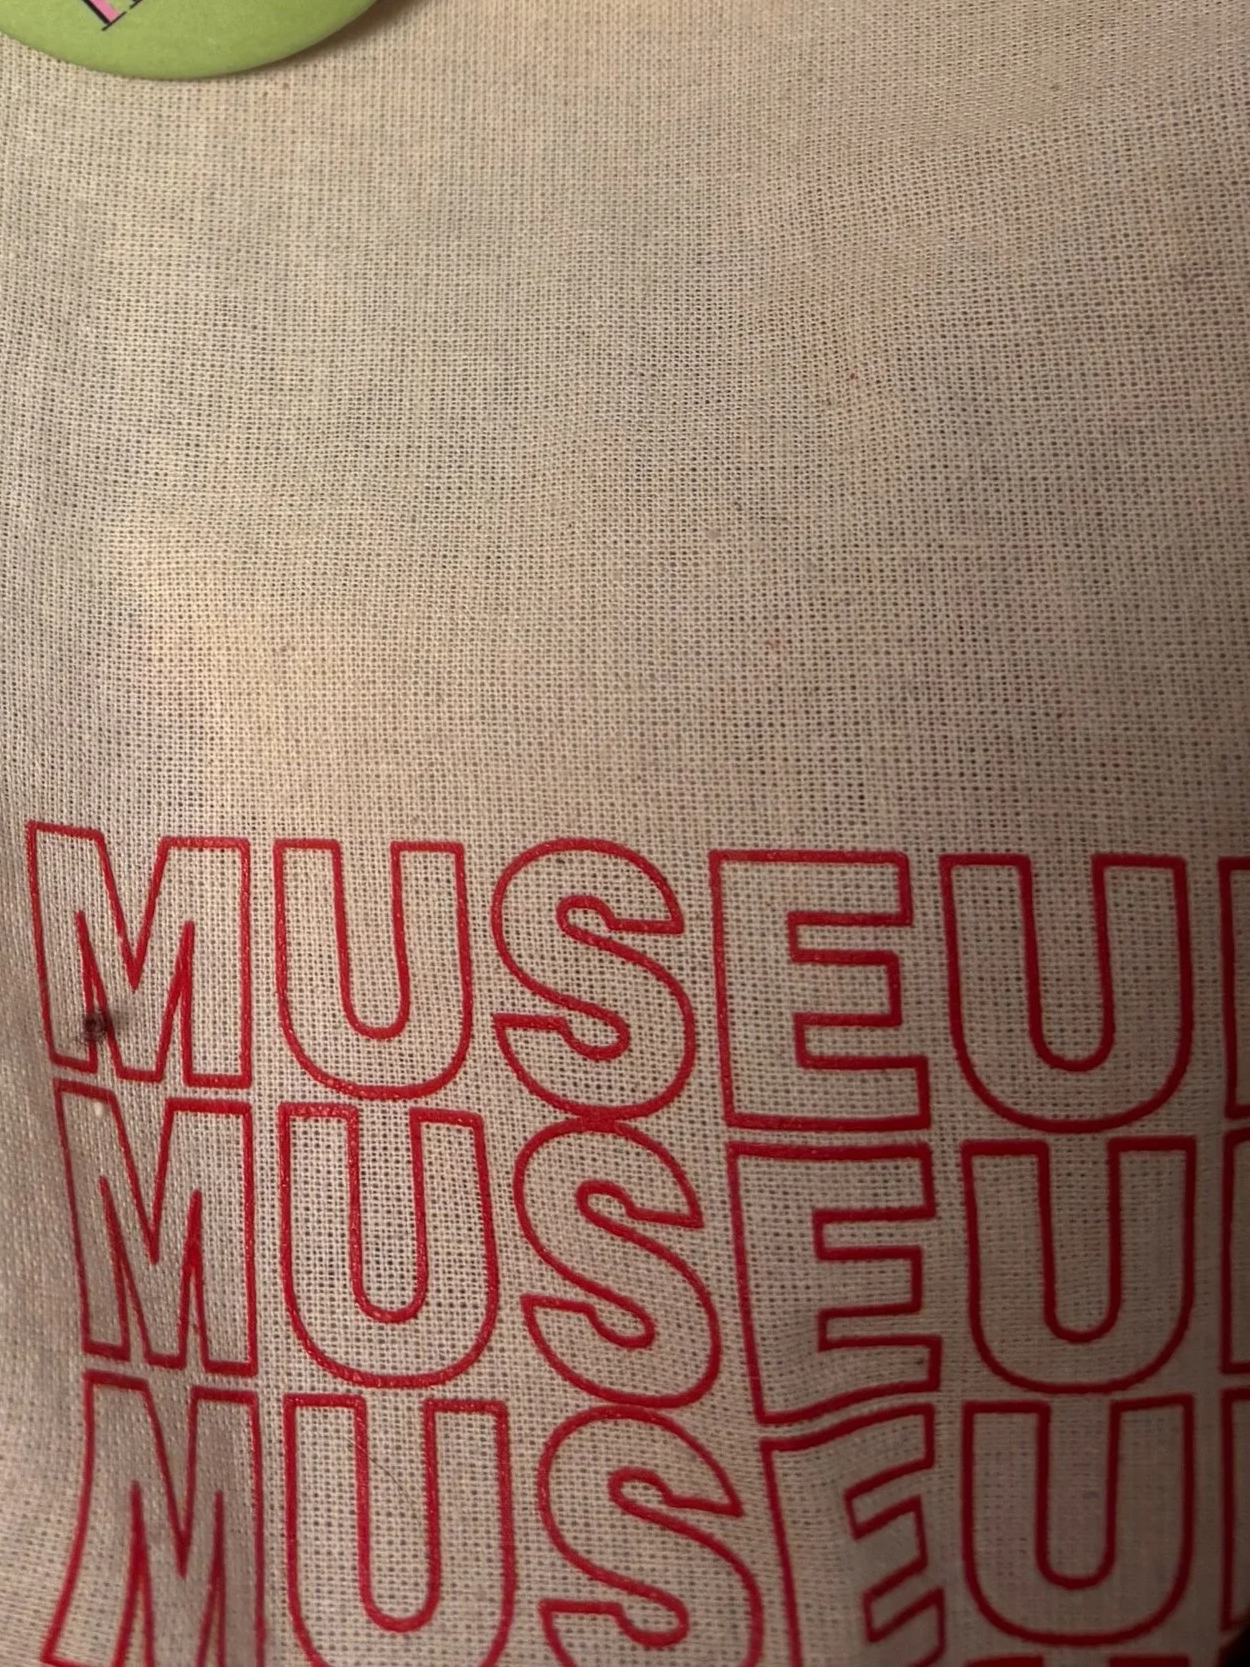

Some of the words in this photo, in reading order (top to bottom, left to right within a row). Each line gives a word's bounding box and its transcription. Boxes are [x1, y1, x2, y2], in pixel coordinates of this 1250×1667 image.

[27, 821, 1250, 1133] MUSEU
[53, 1079, 1250, 1426] MUSEU
[40, 1369, 1250, 1667] MUSEU
